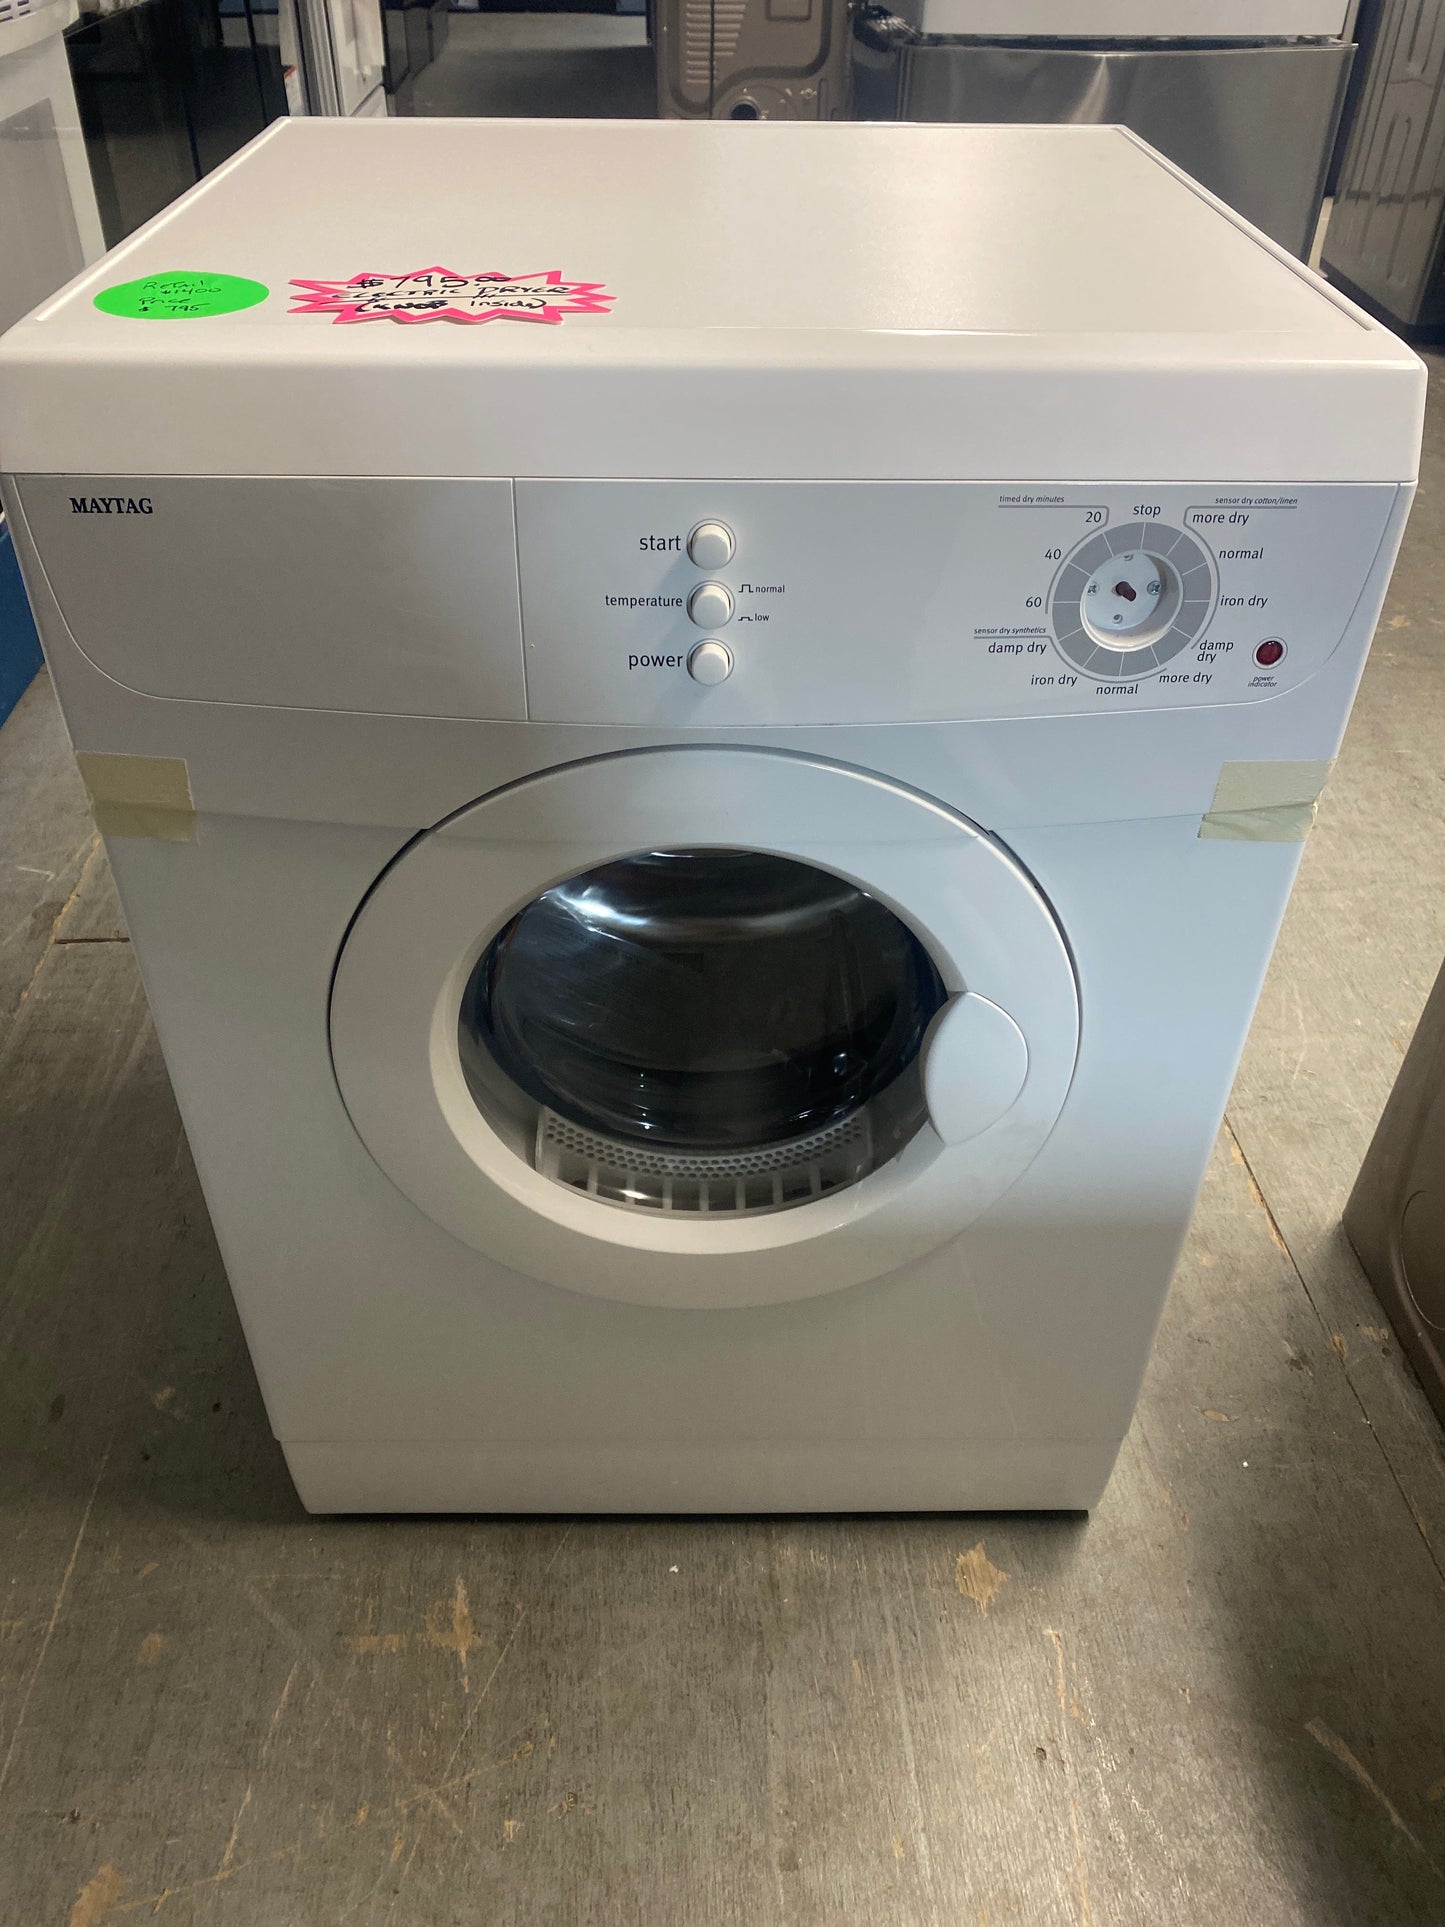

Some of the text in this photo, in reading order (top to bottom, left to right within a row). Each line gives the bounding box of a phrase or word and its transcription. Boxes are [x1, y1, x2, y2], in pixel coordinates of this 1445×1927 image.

[477, 286, 570, 296] DRYER
[999, 495, 1065, 504] timed dry minutes
[1241, 497, 1254, 506] dry
[1254, 497, 1298, 505] cotton/linen
[69, 497, 153, 515] MAYTAG
[1132, 504, 1161, 518] stop
[1085, 511, 1102, 523] 20
[1192, 511, 1250, 526] more dry
[639, 535, 682, 551] start
[1044, 548, 1062, 560] 40
[1218, 547, 1264, 559] normal
[755, 584, 785, 593] normal
[605, 595, 683, 609] temperature
[1025, 596, 1042, 608] 60
[1220, 594, 1268, 608] iron dry
[754, 613, 770, 621] low
[999, 627, 1011, 635] dry
[1012, 627, 1046, 635] synthetics
[988, 641, 1047, 655] damp dry
[1199, 639, 1234, 653] damp
[629, 653, 683, 670] power
[1196, 650, 1217, 664] dry
[1030, 673, 1078, 687] iron dry
[1159, 672, 1213, 685] more dry
[1247, 680, 1278, 688] indicator
[1096, 683, 1139, 695] normal
